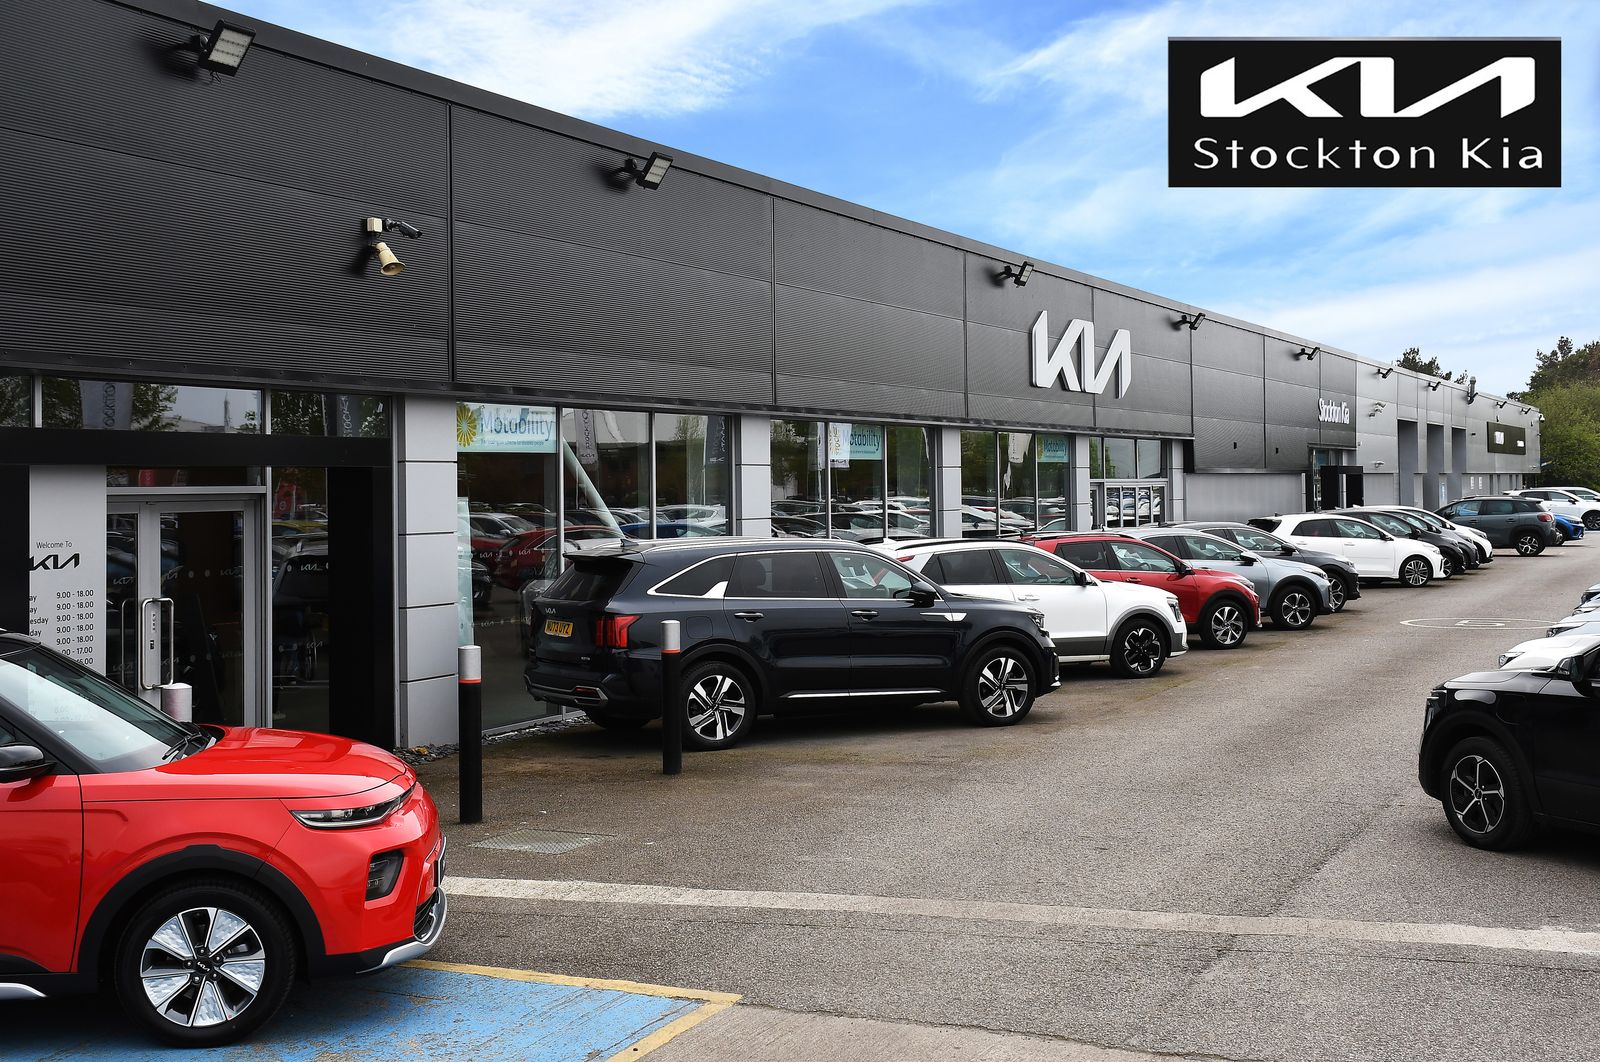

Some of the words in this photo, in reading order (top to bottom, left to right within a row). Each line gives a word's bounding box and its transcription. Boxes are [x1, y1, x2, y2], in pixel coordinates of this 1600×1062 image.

[1031, 310, 1132, 399] KIA
[480, 409, 553, 441] Motability
[842, 429, 881, 451] Motability
[56, 591, 71, 599] 9.00
[76, 589, 94, 597] 18.00
[56, 603, 71, 611] 9.00
[76, 601, 94, 609] 18.00
[56, 614, 71, 622] 9.00
[76, 612, 94, 620] 18.00
[56, 626, 71, 634] 9.00
[76, 624, 94, 632] 18.00
[56, 637, 71, 645] 9.00
[76, 635, 94, 643] 18.00
[76, 646, 93, 655] 17.00
